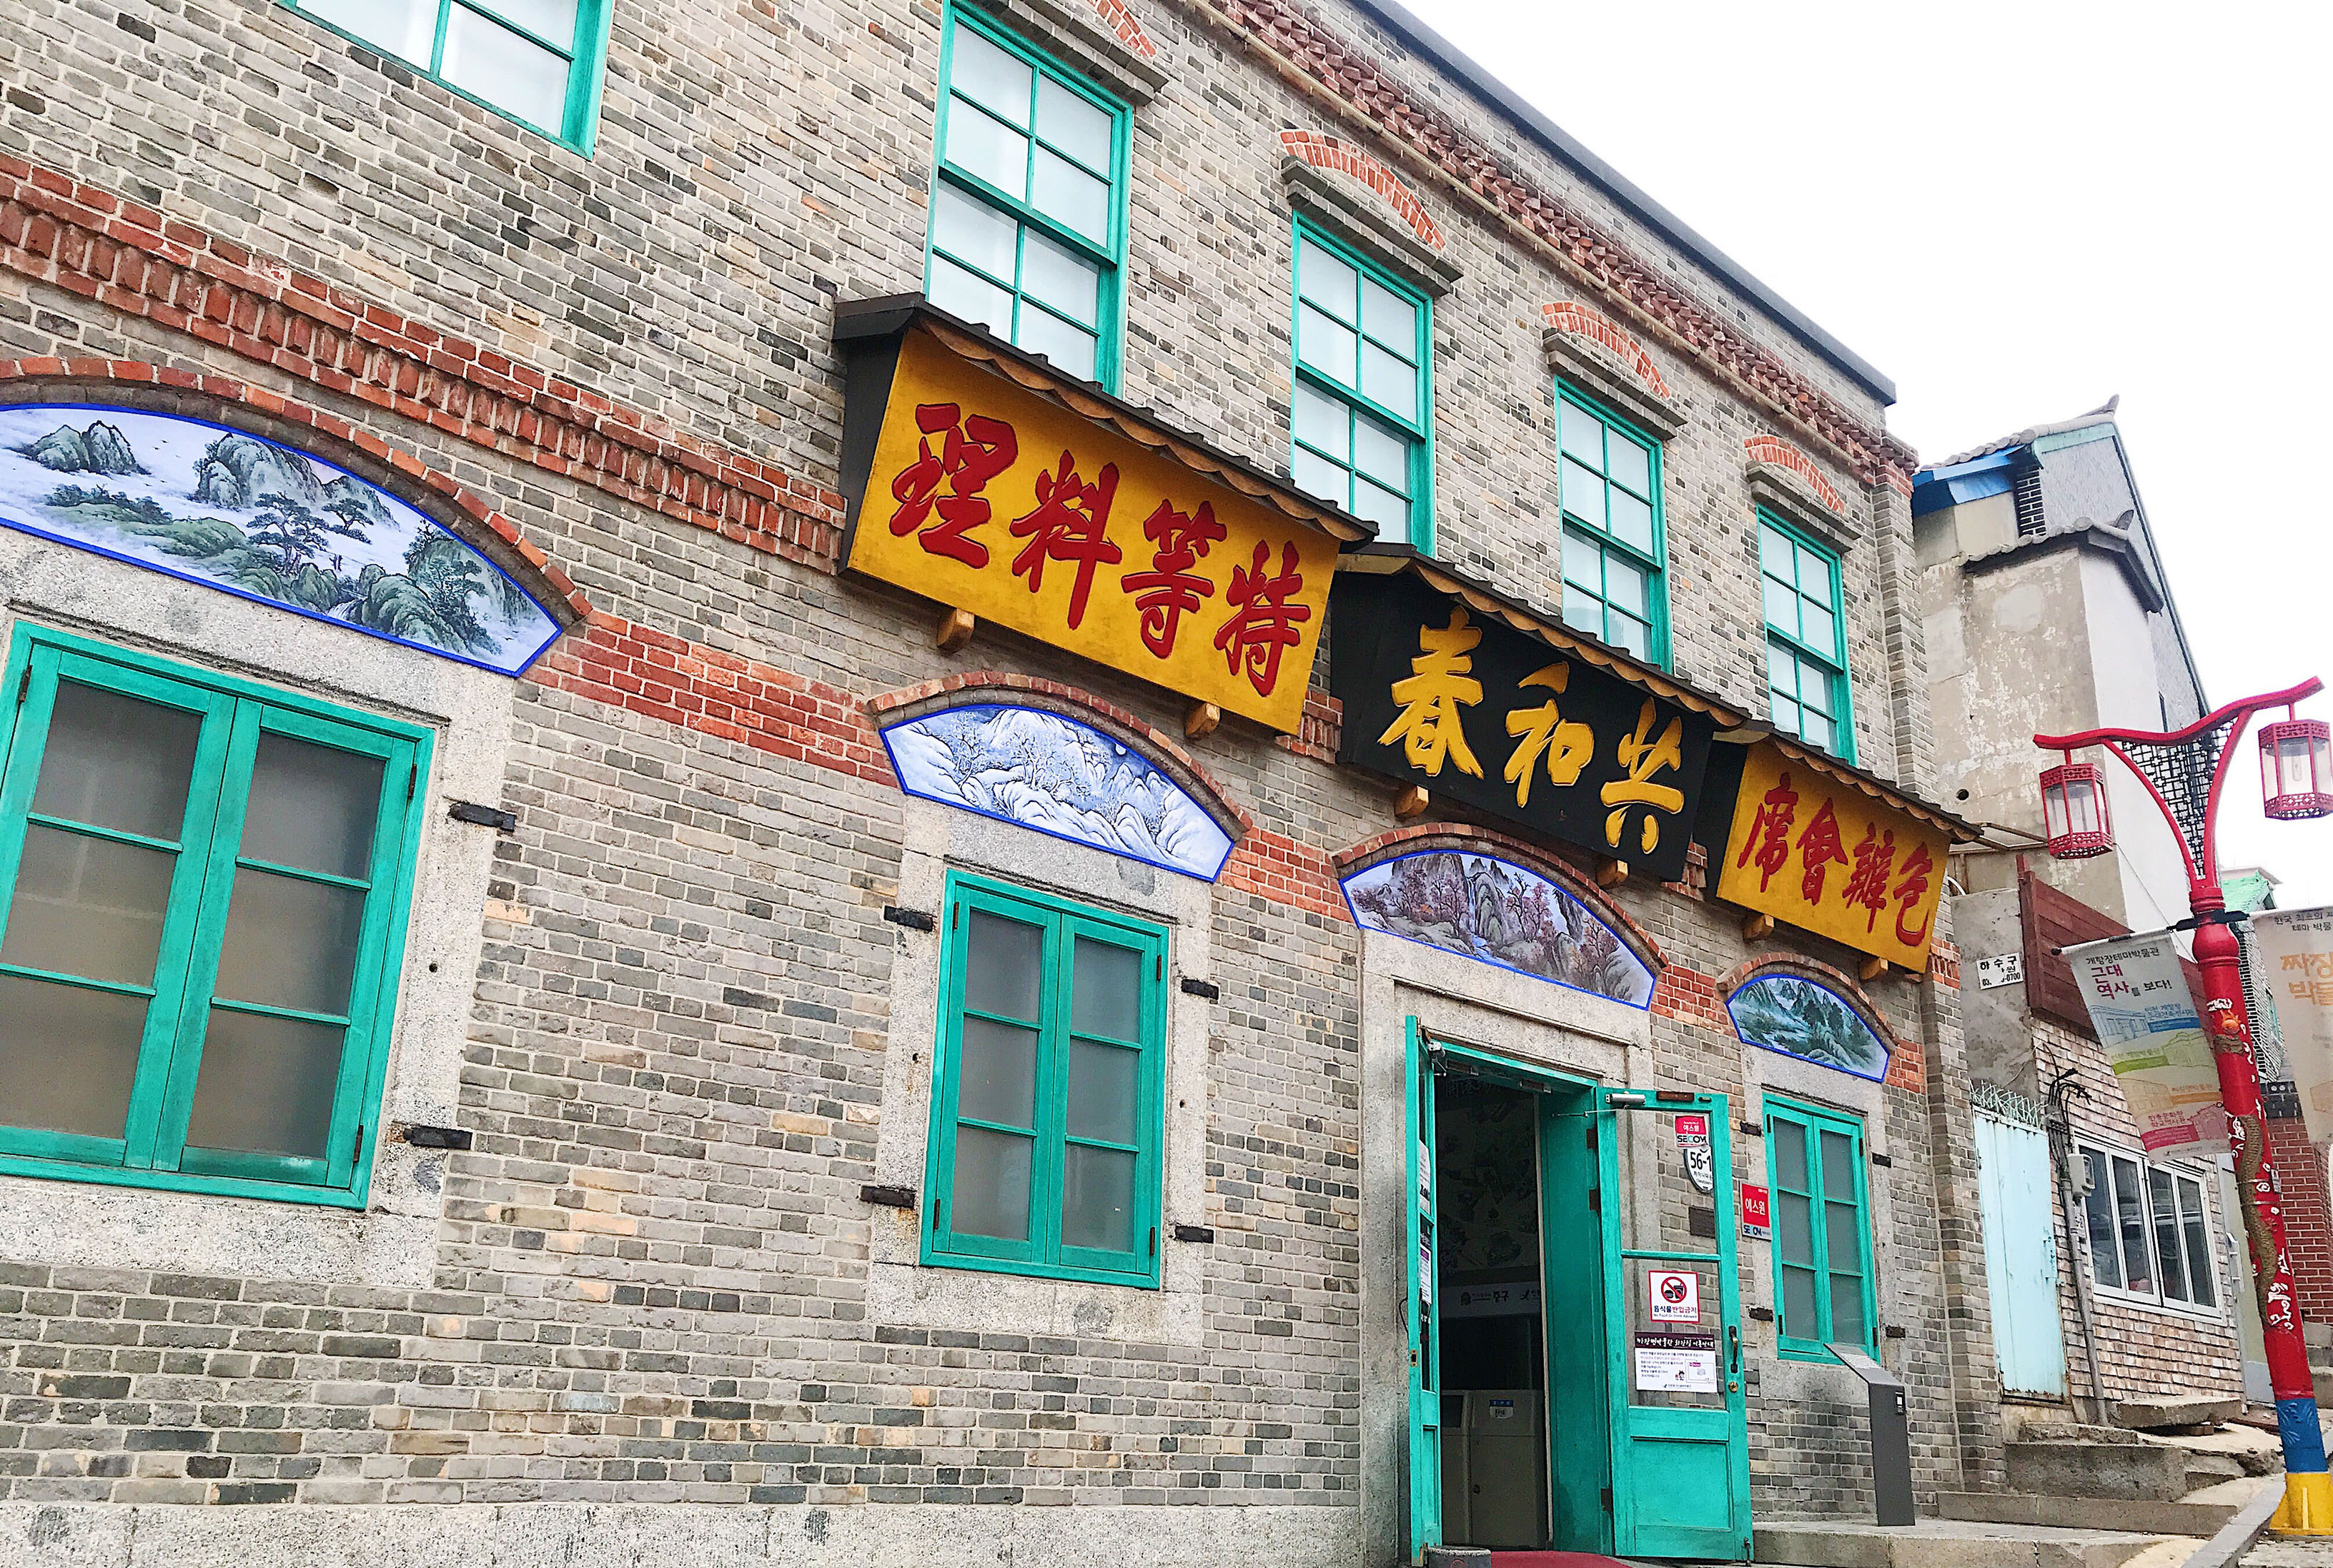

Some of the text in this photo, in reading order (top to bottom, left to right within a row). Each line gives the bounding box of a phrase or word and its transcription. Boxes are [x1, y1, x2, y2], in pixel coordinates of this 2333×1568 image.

[2292, 922, 2310, 931] 테마
[2091, 964, 2124, 984] 근대
[2143, 979, 2172, 992] 보다!
[1677, 1135, 1707, 1143] SECOM
[1745, 1198, 1765, 1216] 에스원
